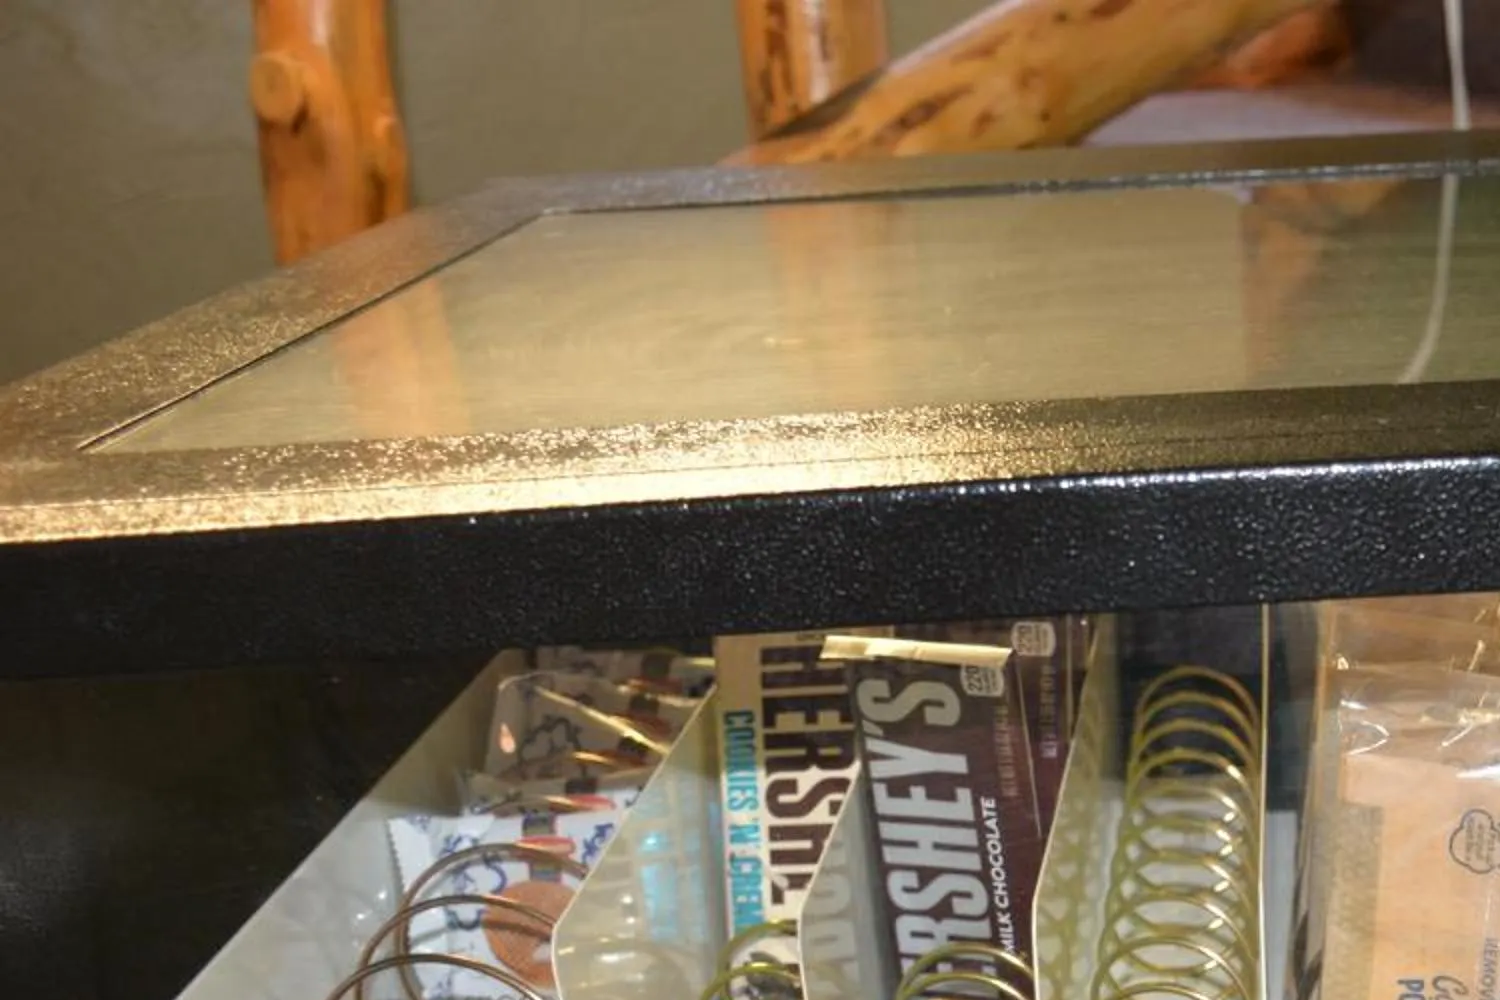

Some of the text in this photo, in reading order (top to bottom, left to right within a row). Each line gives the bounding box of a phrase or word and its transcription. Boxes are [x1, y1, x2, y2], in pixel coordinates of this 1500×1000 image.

[723, 710, 761, 811] COOKIES
[730, 854, 765, 936] CREM
[980, 796, 1010, 908] CHOCOLATE
[998, 908, 1016, 956] MILK
